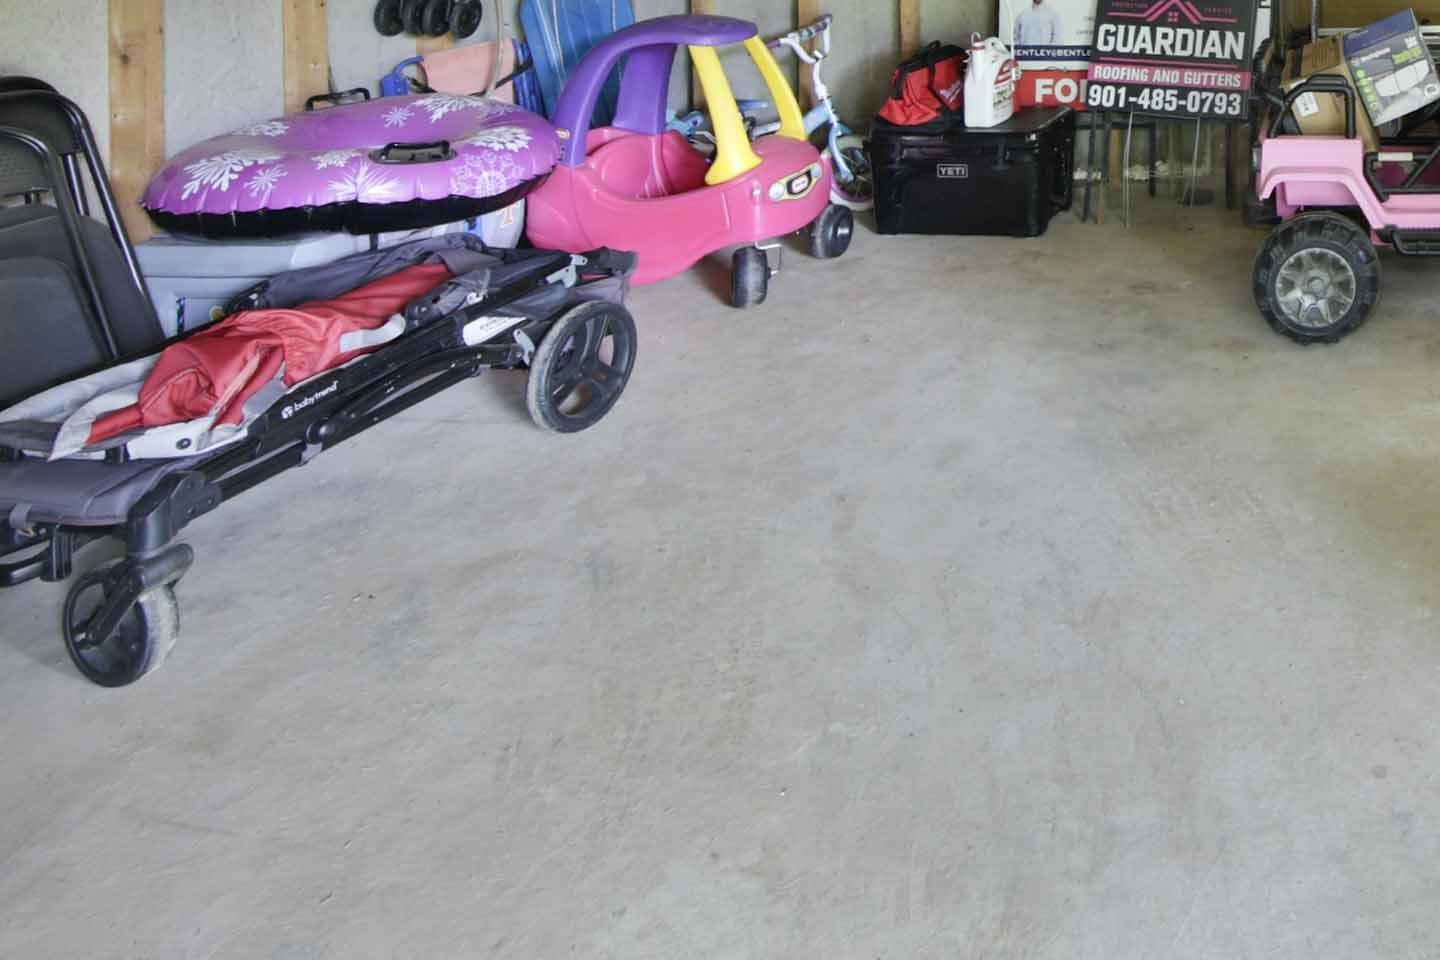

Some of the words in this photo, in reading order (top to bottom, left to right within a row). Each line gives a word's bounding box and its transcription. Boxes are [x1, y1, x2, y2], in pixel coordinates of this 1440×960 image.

[1096, 23, 1246, 60] GUARDIAN
[1093, 65, 1149, 83] ROOFING
[1152, 69, 1180, 84] AND
[1183, 71, 1241, 88] GUTTERS
[1087, 84, 1242, 116] 901-485-0793
[940, 167, 965, 176] YETI
